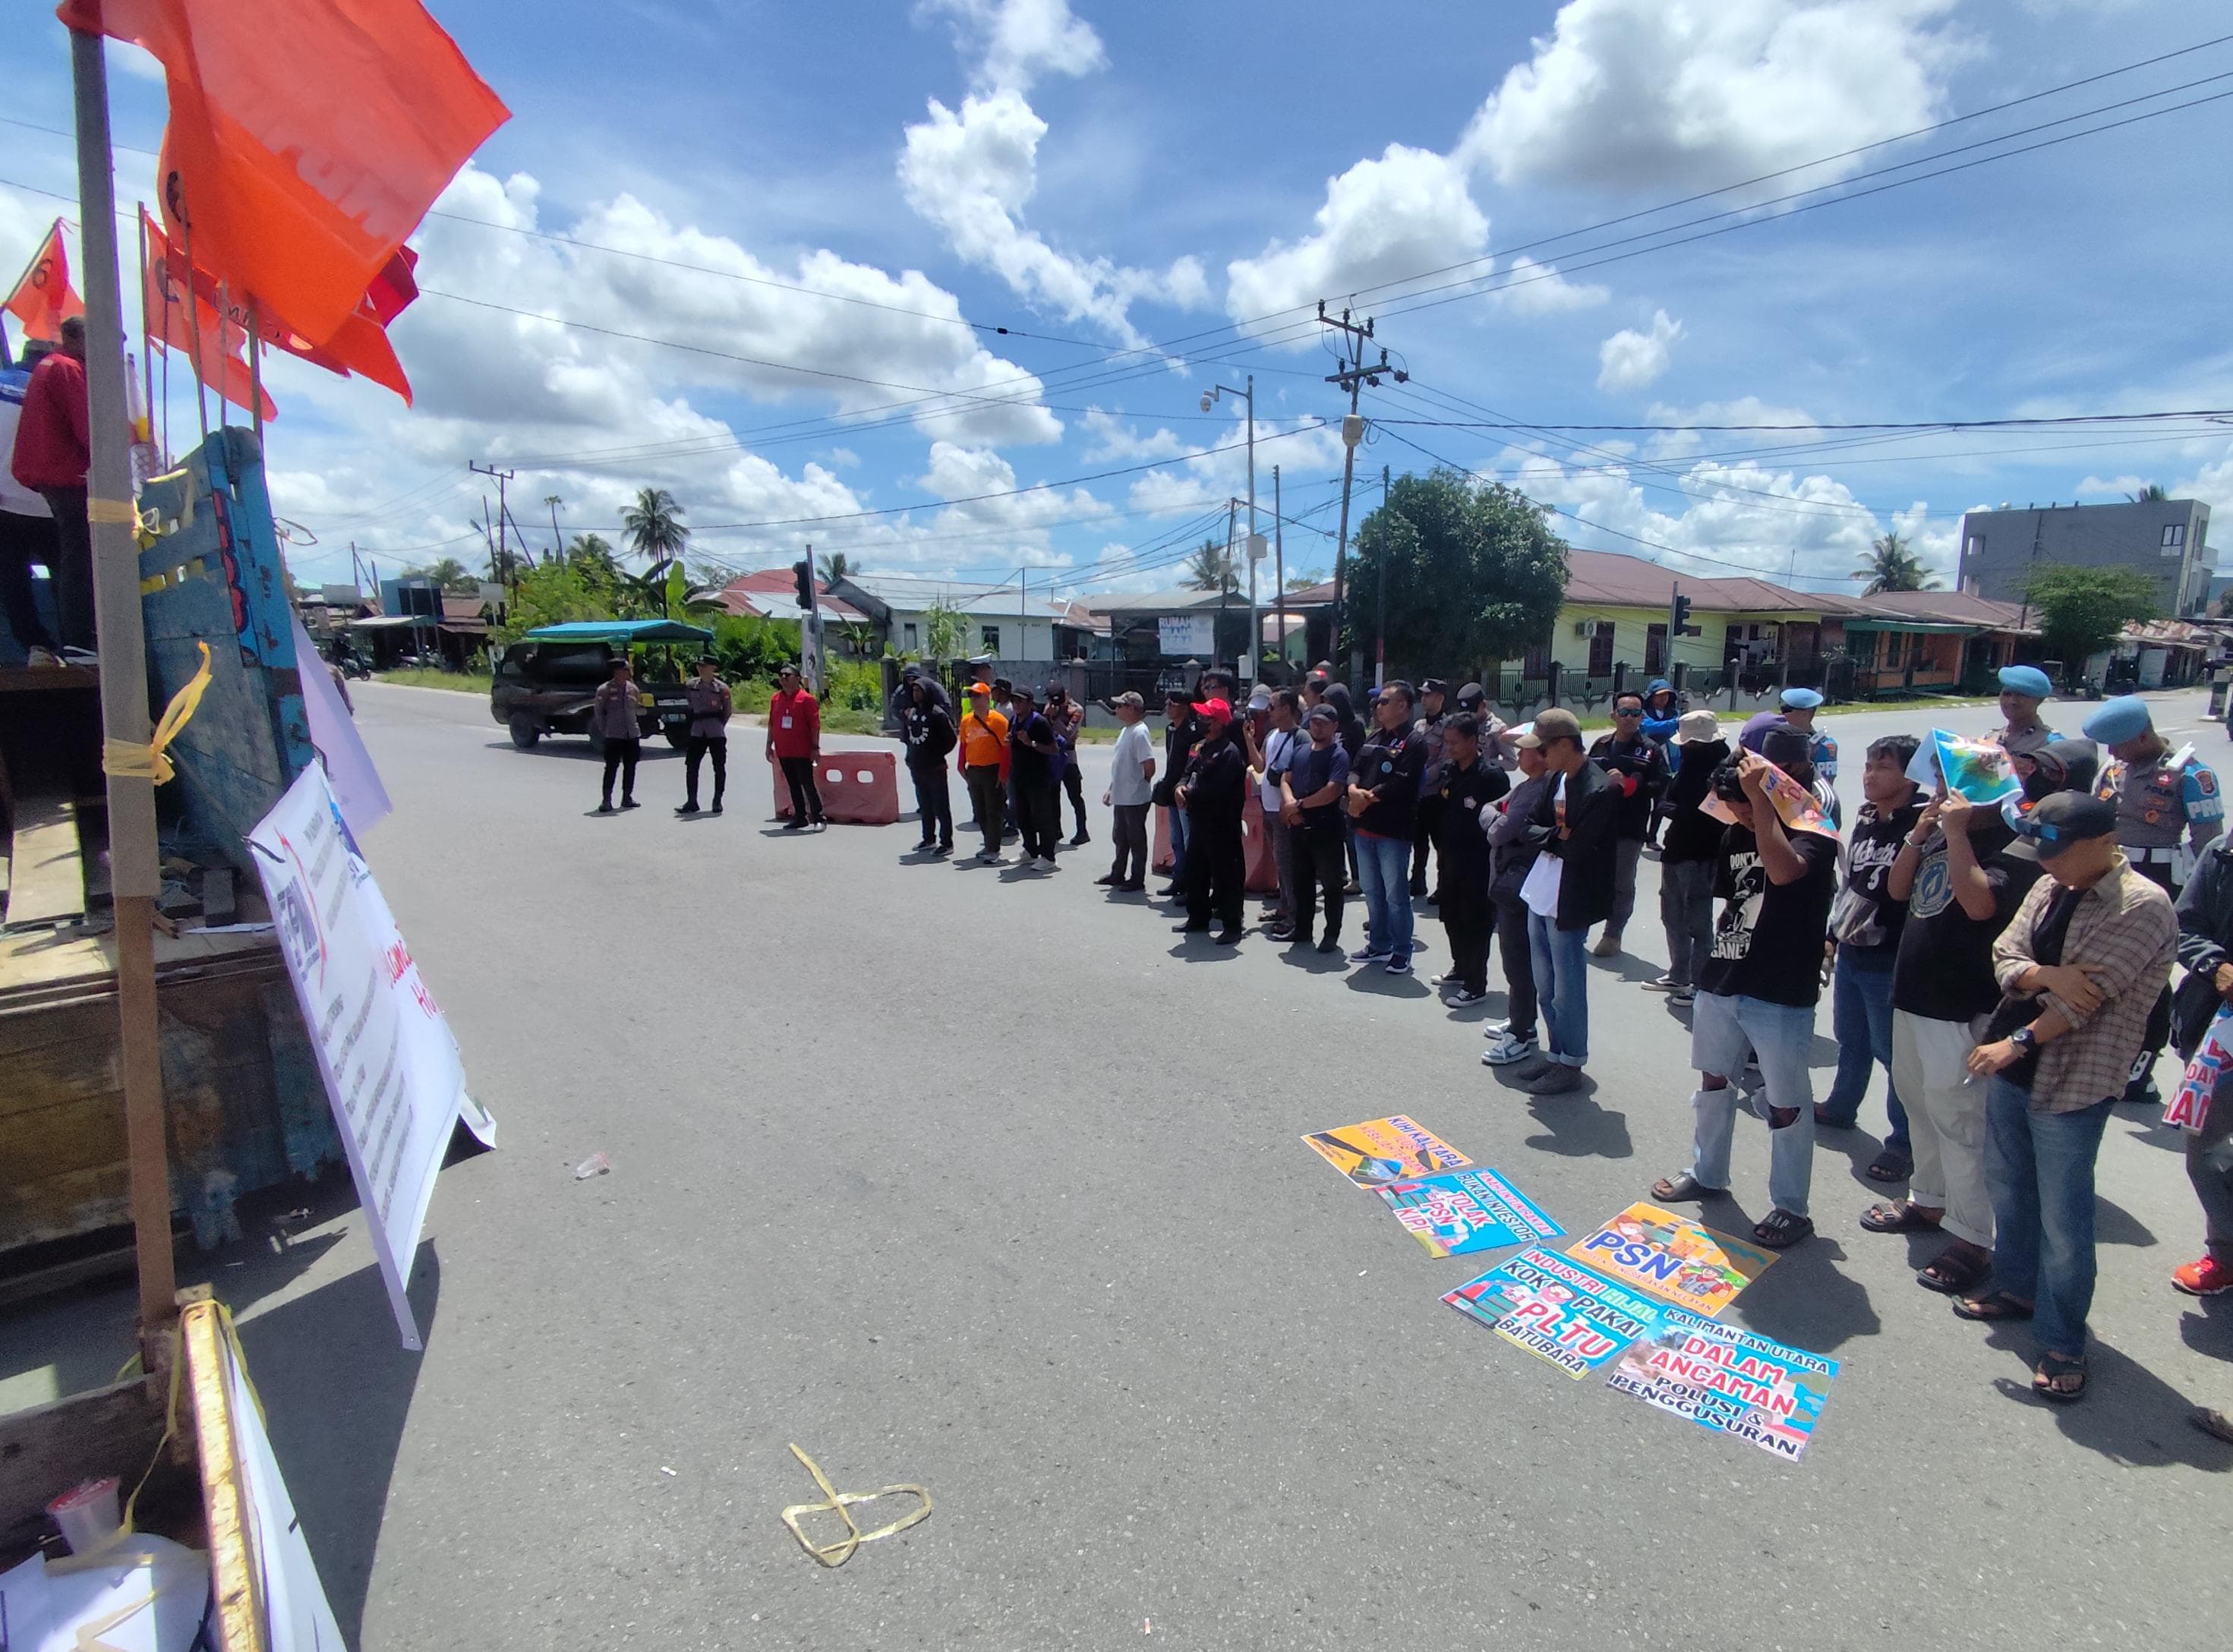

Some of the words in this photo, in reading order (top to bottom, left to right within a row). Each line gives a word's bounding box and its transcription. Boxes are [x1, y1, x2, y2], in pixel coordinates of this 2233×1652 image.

[1389, 1118, 1417, 1133] KIHI
[1408, 1130, 1464, 1167] KALTARA
[1395, 1207, 1431, 1231] KIPI
[1422, 1201, 1459, 1225] PSN
[1446, 1191, 1493, 1226] TOLAK
[1458, 1173, 1488, 1200] BUKAN
[1486, 1200, 1536, 1240] INVESTOR
[1522, 1250, 1607, 1294] INDUSTRI
[1585, 1231, 1683, 1281] PSN
[1503, 1261, 1553, 1289] KOK
[1572, 1296, 1645, 1338] PAKAI
[1497, 1318, 1586, 1373] BATUBARA
[1515, 1301, 1614, 1357] PLTU
[1666, 1308, 1770, 1352] KALIMANTAN
[1771, 1347, 1828, 1373] UTARA
[1649, 1351, 1796, 1416] ANCAMAN
[1683, 1337, 1785, 1386] DALAM
[1654, 1376, 1742, 1417] POLUSI
[1747, 1412, 1765, 1427] &
